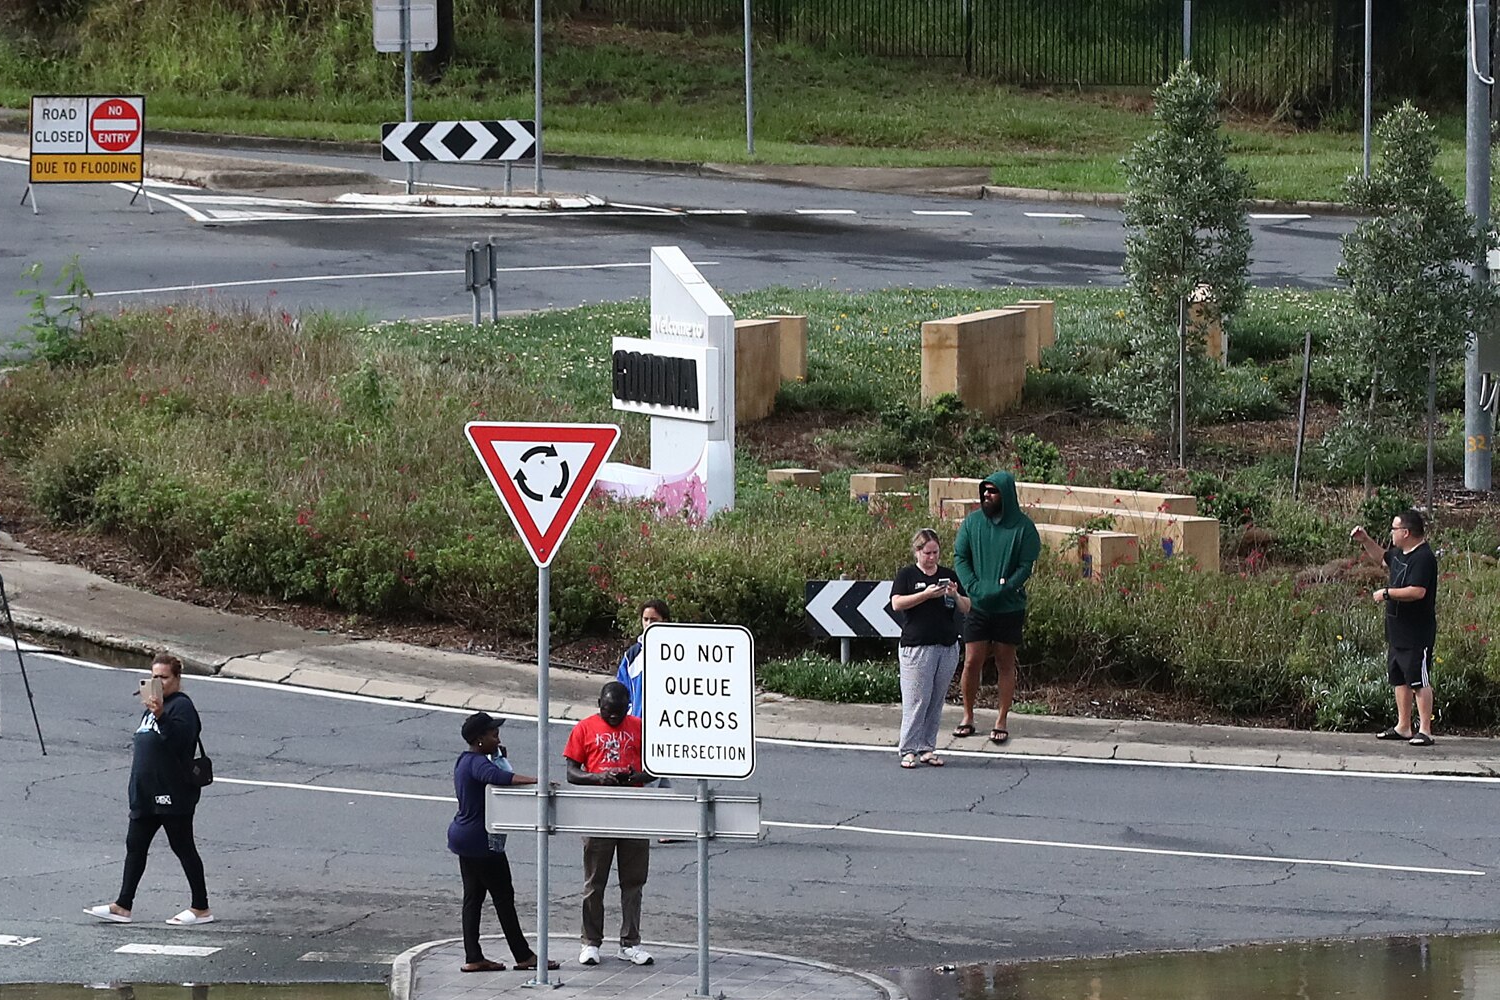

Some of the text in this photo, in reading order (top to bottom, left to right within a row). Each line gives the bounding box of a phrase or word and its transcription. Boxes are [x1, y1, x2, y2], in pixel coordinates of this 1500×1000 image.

[42, 108, 77, 120] ROAD
[108, 106, 123, 116] NO
[35, 131, 84, 143] CLOSED
[98, 133, 131, 143] ENTRY
[36, 162, 137, 174] DUE TO FLOODING
[612, 350, 699, 411] GOODNA
[660, 643, 735, 663] DO NOT
[665, 677, 731, 696] QUEUE
[659, 710, 738, 730] ACROSS
[651, 743, 746, 761] INTERSECTION
